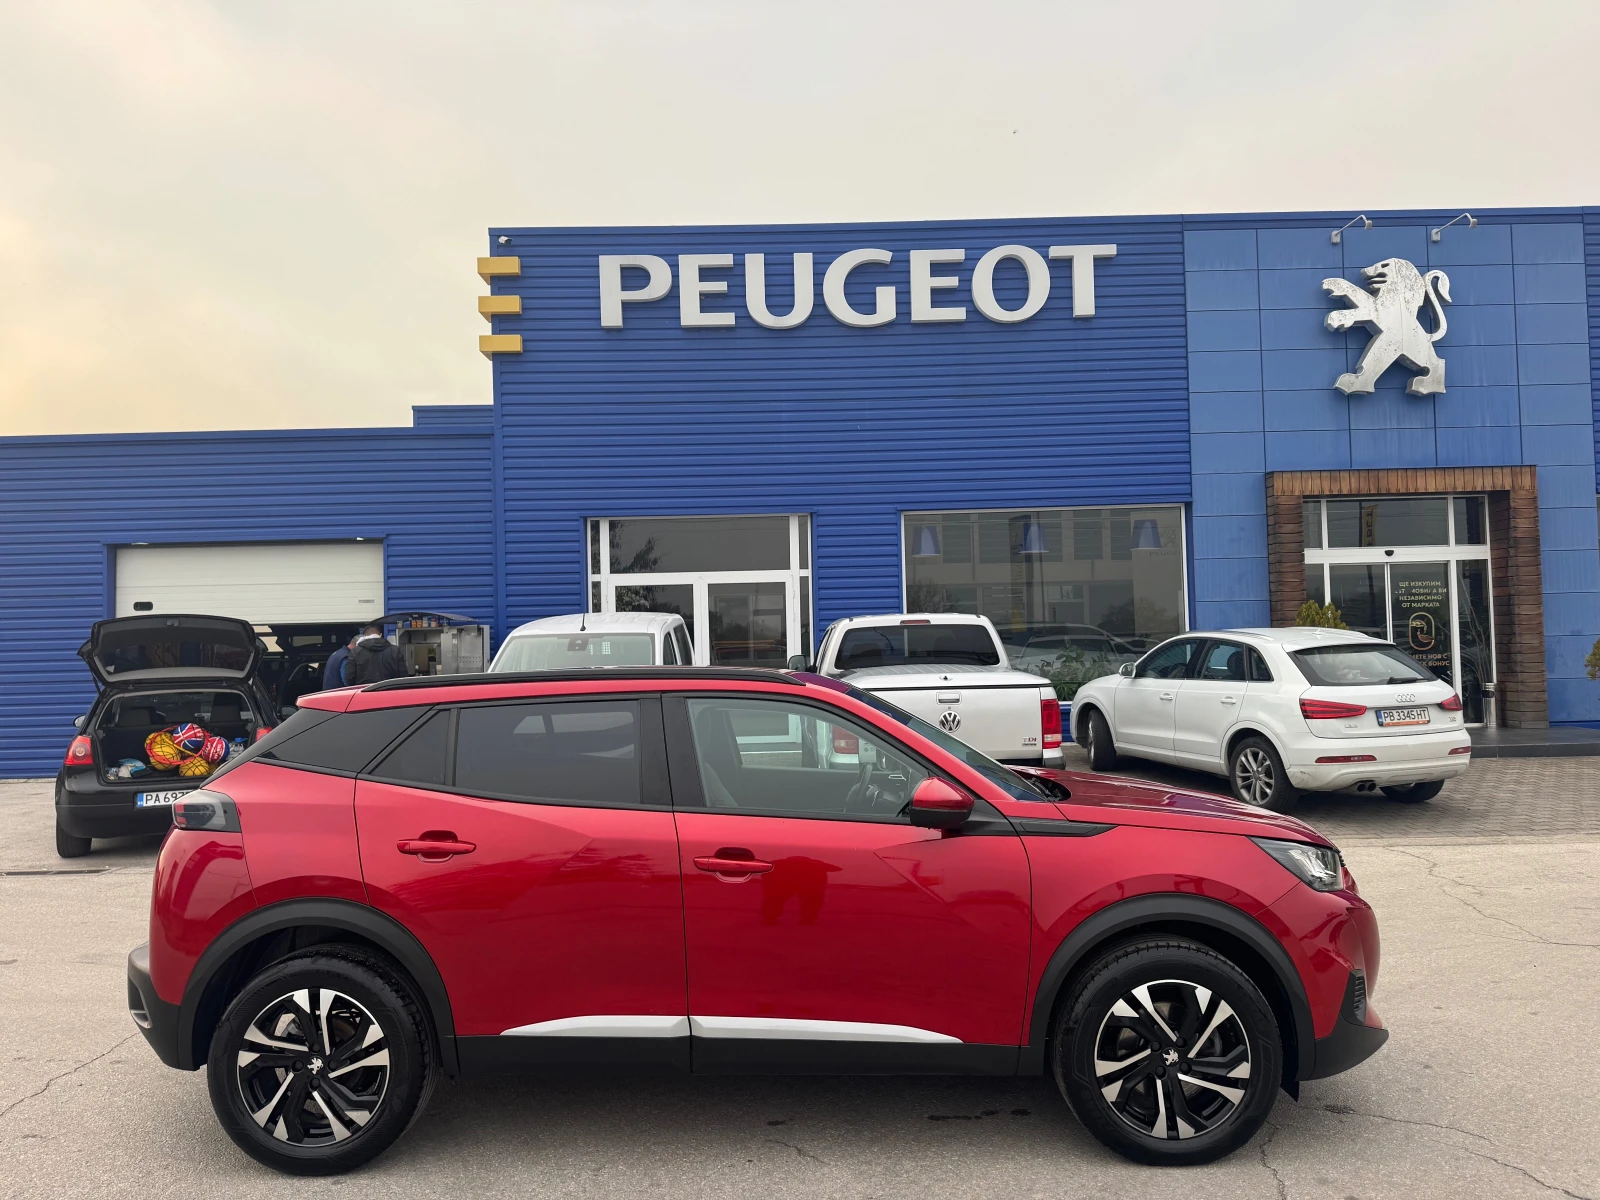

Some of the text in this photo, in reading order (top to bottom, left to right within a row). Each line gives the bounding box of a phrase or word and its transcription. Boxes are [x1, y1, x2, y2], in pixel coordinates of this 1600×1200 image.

[599, 244, 1118, 329] PEUGEOT
[1383, 709, 1427, 721] PB 3345 HT
[145, 793, 161, 804] PA
